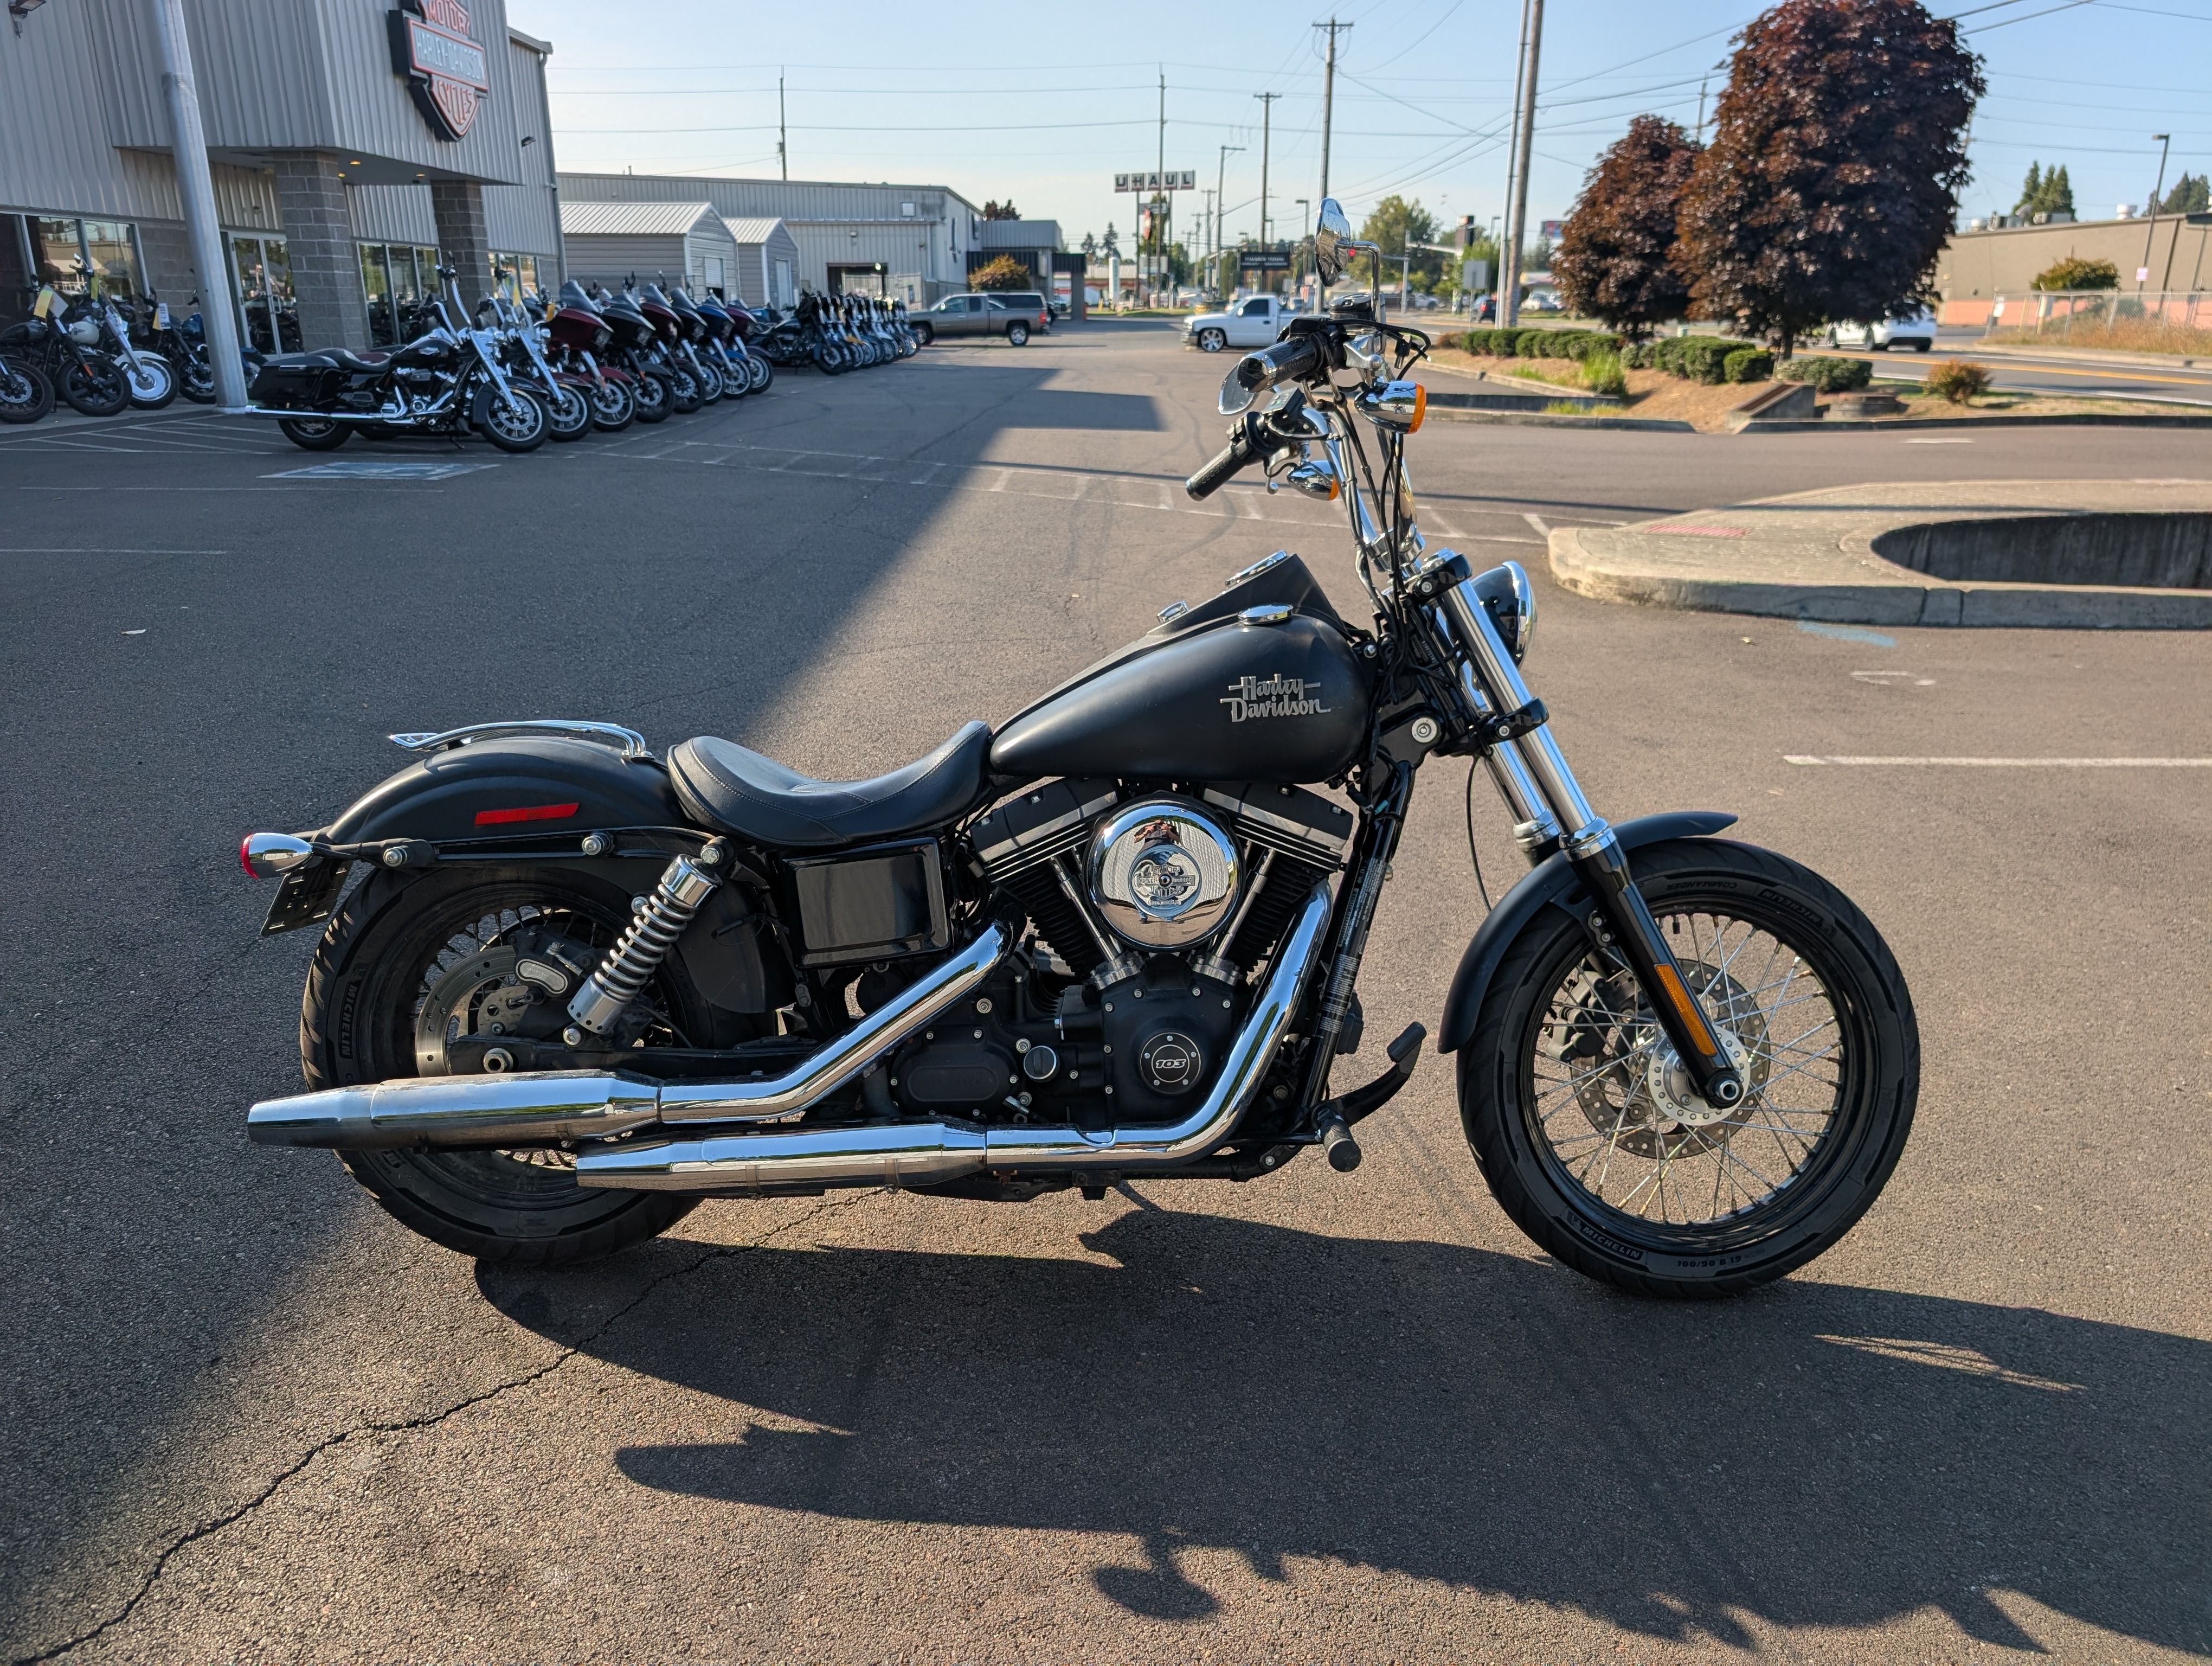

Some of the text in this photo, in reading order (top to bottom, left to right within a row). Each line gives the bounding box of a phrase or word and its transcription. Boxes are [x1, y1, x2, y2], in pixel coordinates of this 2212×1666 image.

[437, 80, 472, 125] CYCLES
[1229, 674, 1321, 701] Harley
[1220, 695, 1331, 722] Davidson
[1667, 881, 1737, 890] COMMANDER
[1762, 891, 1821, 922] MICHELIN
[342, 984, 358, 1056] MICHELIN
[1156, 1059, 1186, 1068] 103
[1583, 1227, 1640, 1258] MICHELIN
[1730, 1255, 1741, 1264] 19
